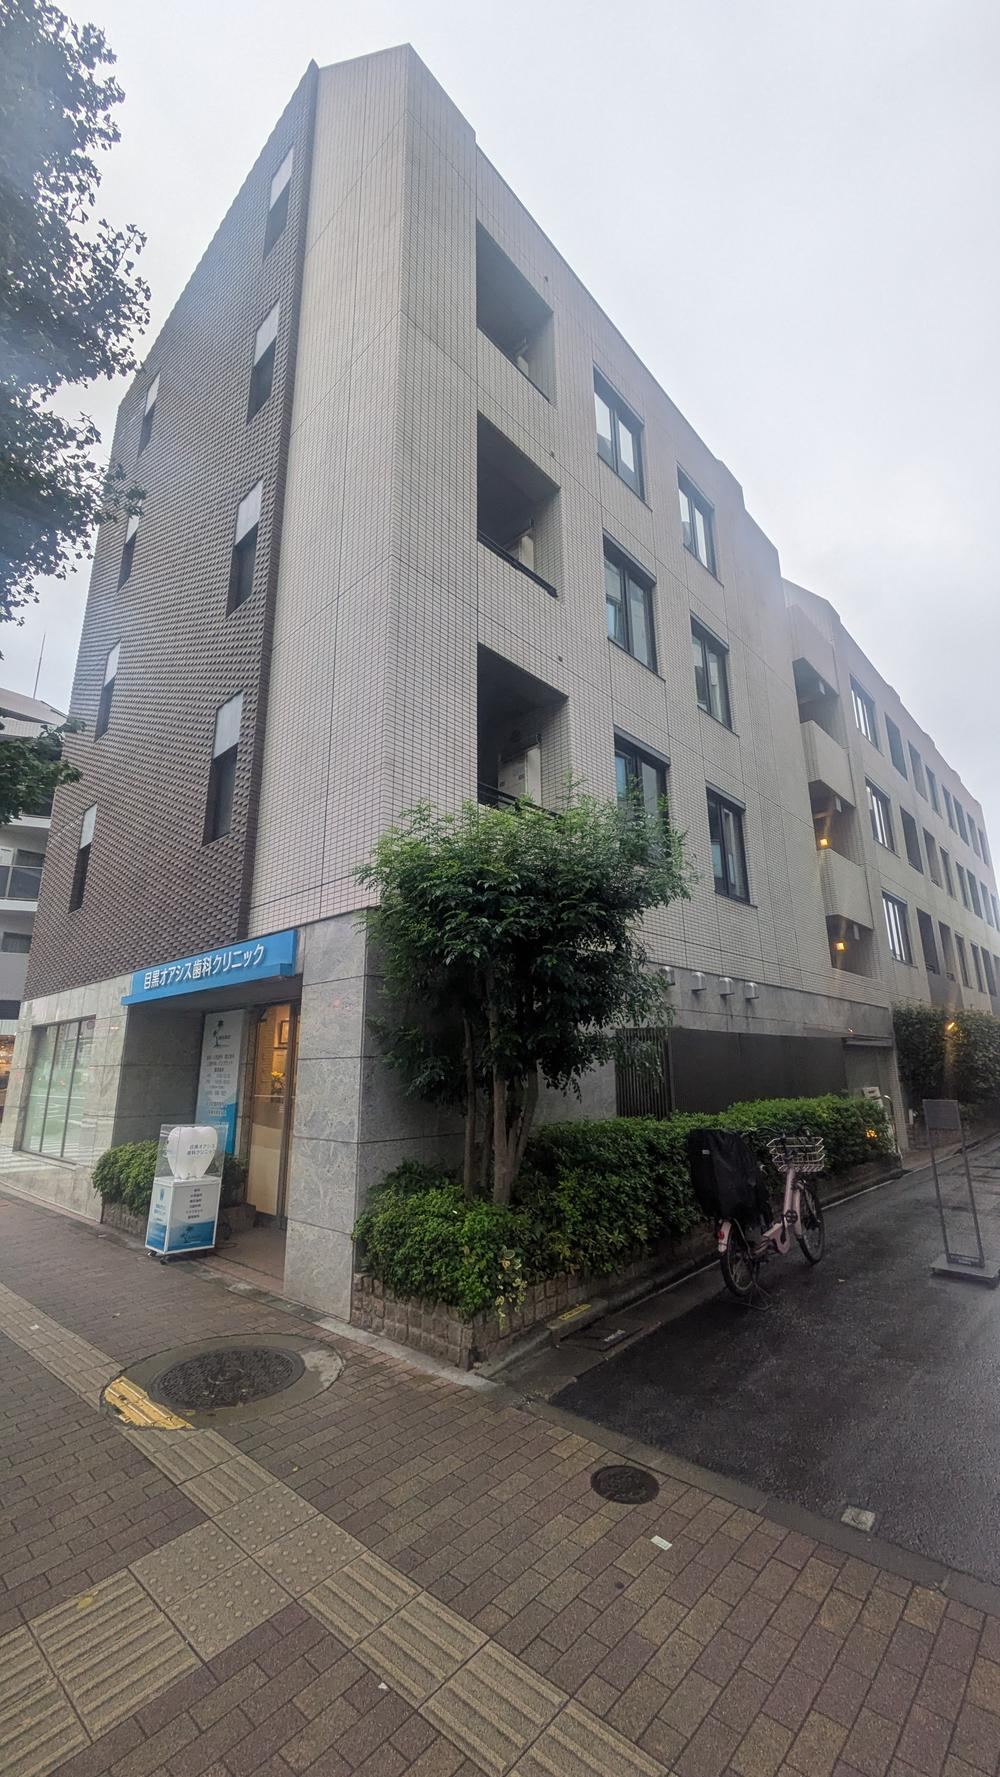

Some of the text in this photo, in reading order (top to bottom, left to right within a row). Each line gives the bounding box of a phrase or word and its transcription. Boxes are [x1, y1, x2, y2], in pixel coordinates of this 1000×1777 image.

[143, 943, 265, 989] 目黒オアシス歯科クリニック
